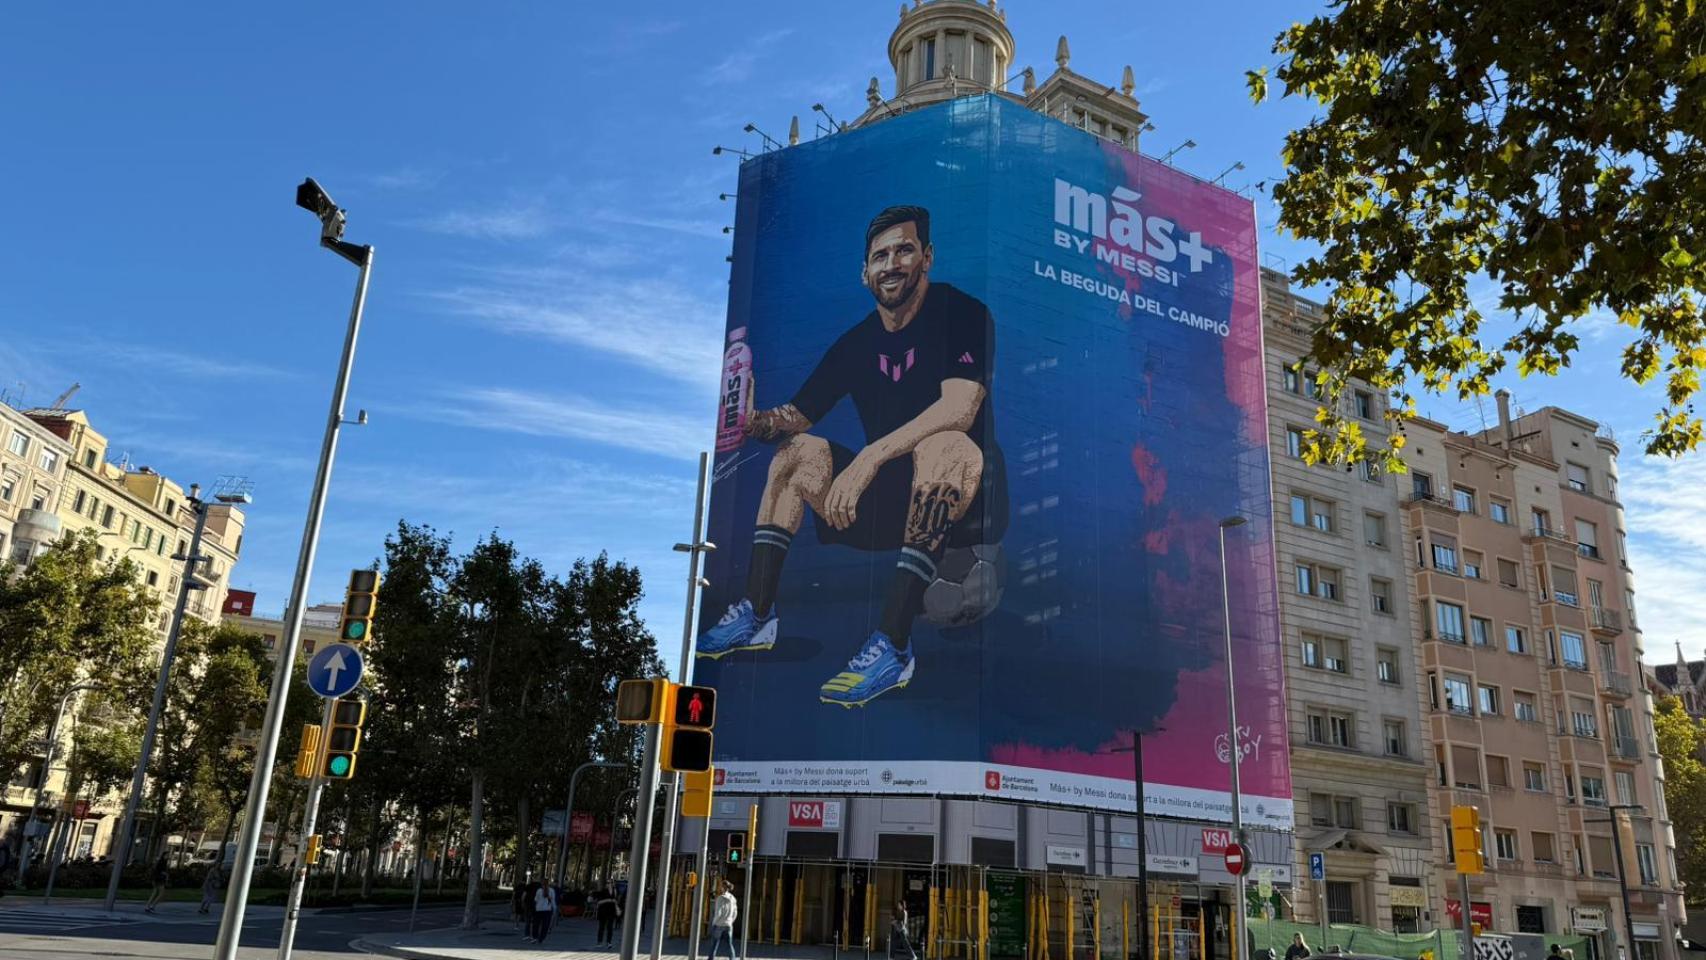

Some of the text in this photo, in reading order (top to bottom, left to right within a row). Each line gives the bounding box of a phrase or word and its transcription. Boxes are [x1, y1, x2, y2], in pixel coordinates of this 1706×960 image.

[1053, 228, 1179, 287] BY MESSI
[1034, 260, 1230, 337] LA BEGUDA DEL CAMPIÓ
[804, 767, 825, 775] Messi
[826, 767, 843, 775] dona
[1073, 786, 1083, 797] by
[1084, 787, 1106, 798] Messi
[1108, 791, 1127, 800] dona
[1159, 795, 1166, 805] la
[1167, 797, 1191, 808] millora
[1192, 799, 1204, 809] del
[791, 803, 821, 819] VSA
[1203, 831, 1229, 848] VSA
[1313, 855, 1320, 867] P
